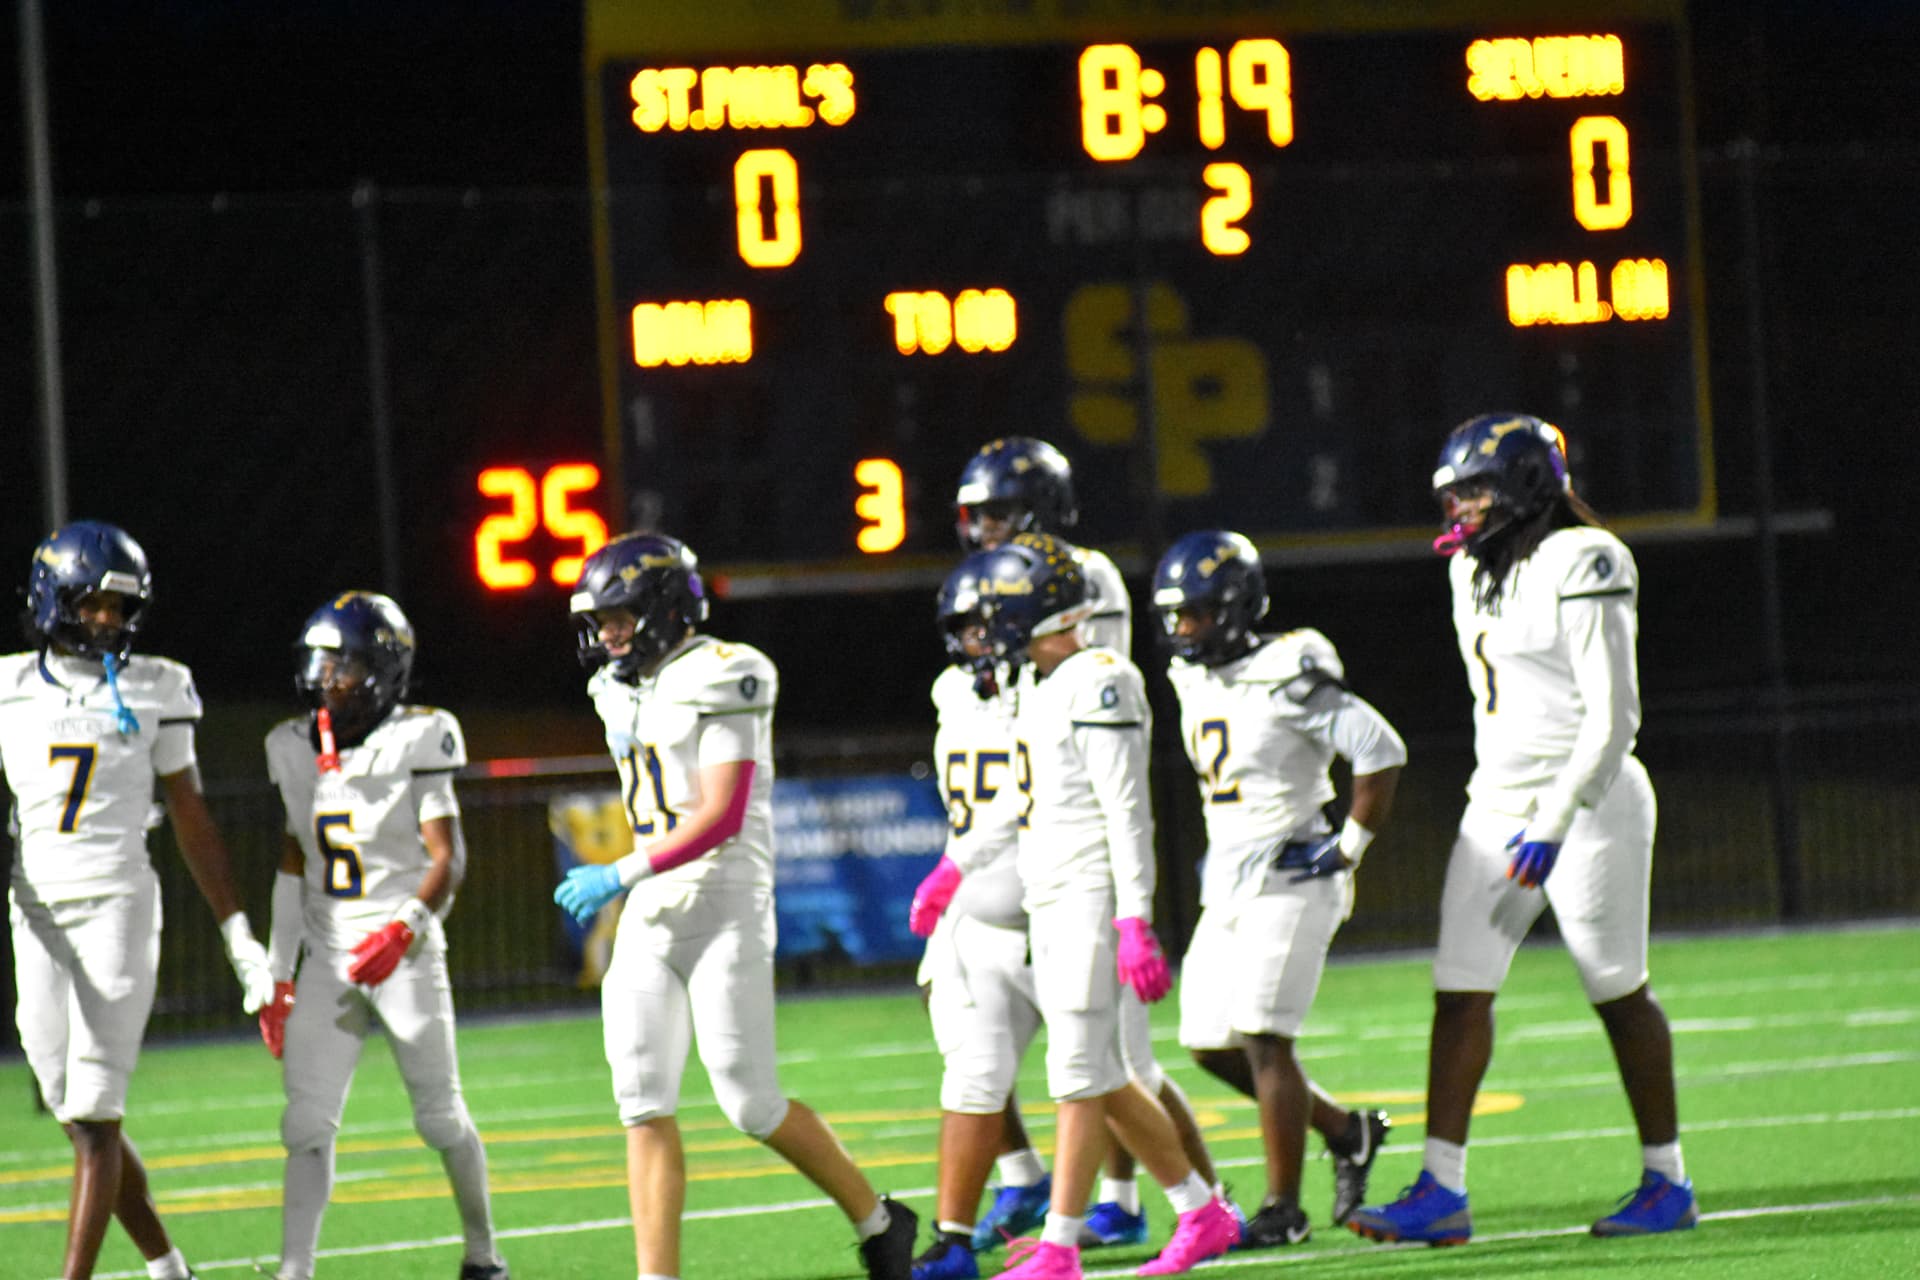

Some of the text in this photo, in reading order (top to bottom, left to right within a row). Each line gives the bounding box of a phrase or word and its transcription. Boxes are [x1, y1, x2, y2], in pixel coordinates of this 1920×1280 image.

[1079, 39, 1294, 162] 8:19
[734, 149, 802, 268] 0
[1201, 163, 1253, 256] 2
[1570, 116, 1632, 230] 0
[474, 462, 608, 588] 25
[855, 459, 905, 553] 3
[1474, 630, 1497, 715] 1
[48, 742, 98, 834] 7
[314, 810, 367, 900] 6
